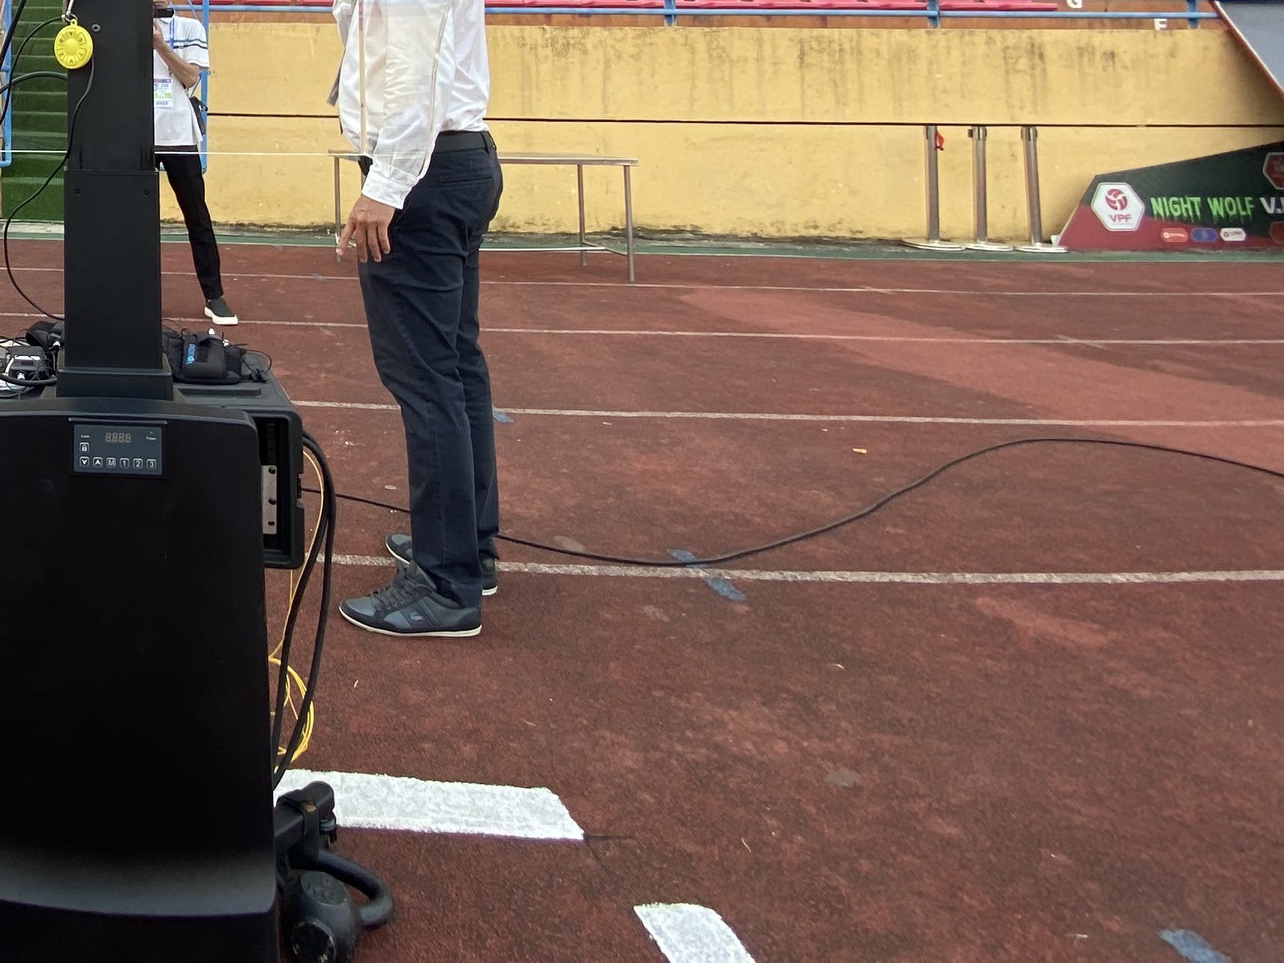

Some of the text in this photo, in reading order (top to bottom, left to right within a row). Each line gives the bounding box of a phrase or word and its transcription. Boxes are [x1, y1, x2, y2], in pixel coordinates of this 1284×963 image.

[1150, 196, 1202, 221] NIGHT
[1206, 196, 1255, 222] WOLF
[1109, 214, 1132, 223] VPF
